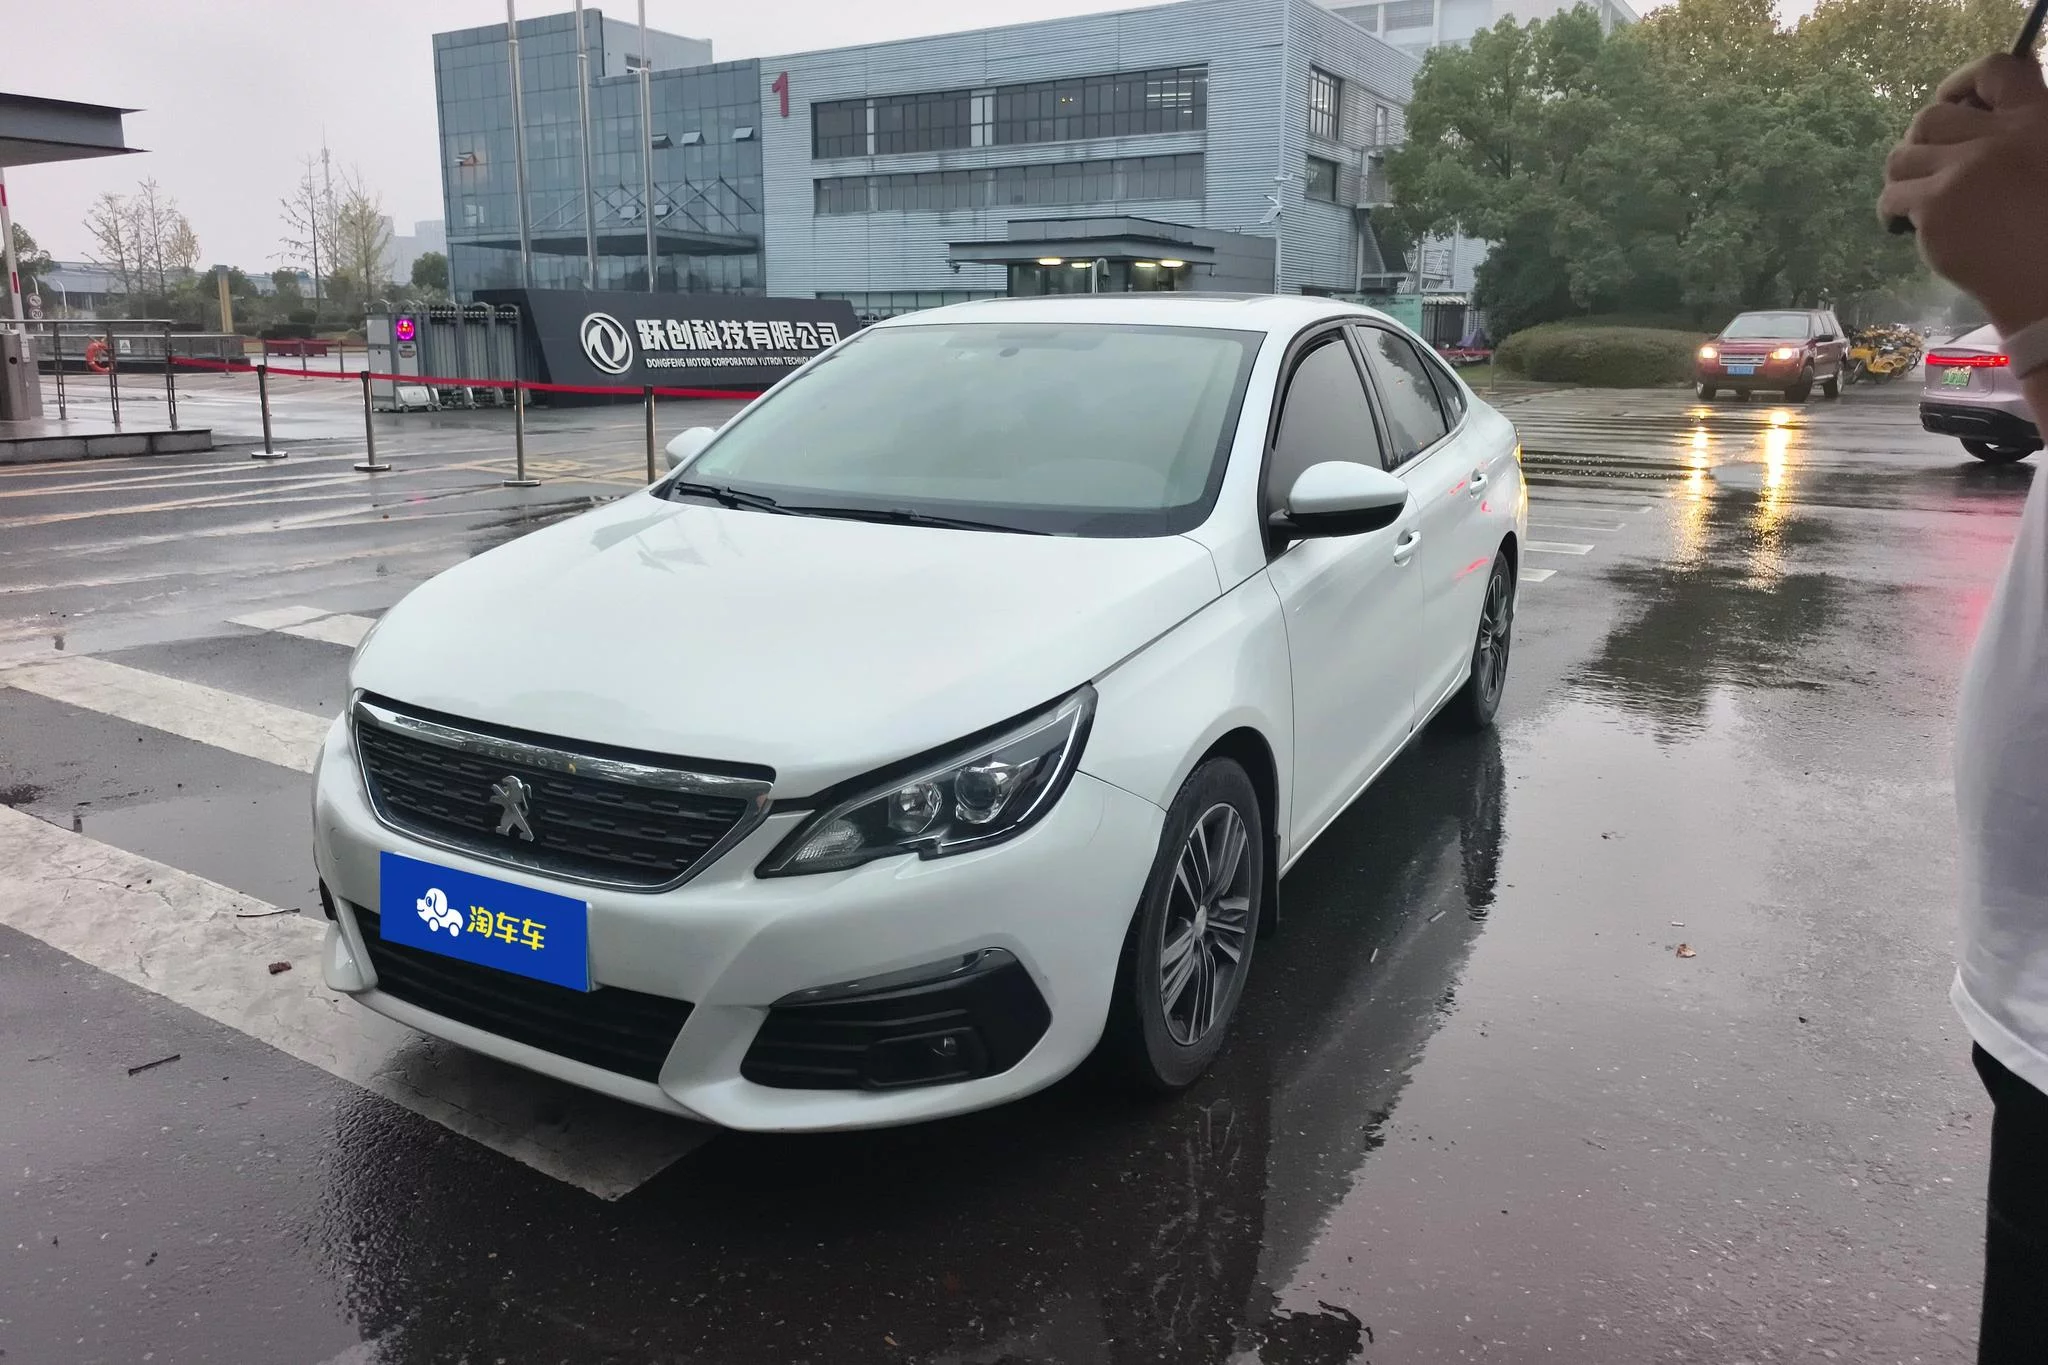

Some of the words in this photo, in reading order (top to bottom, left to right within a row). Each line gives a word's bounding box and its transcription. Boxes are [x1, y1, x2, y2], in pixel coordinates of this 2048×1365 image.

[771, 71, 789, 118] 1
[33, 310, 42, 318] 20
[635, 319, 840, 350] 跃创科技有限公司
[646, 357, 686, 368] DONGFENG
[686, 357, 711, 367] MOTOR
[711, 356, 757, 367] CORPORATION
[757, 356, 783, 366] YUTRON
